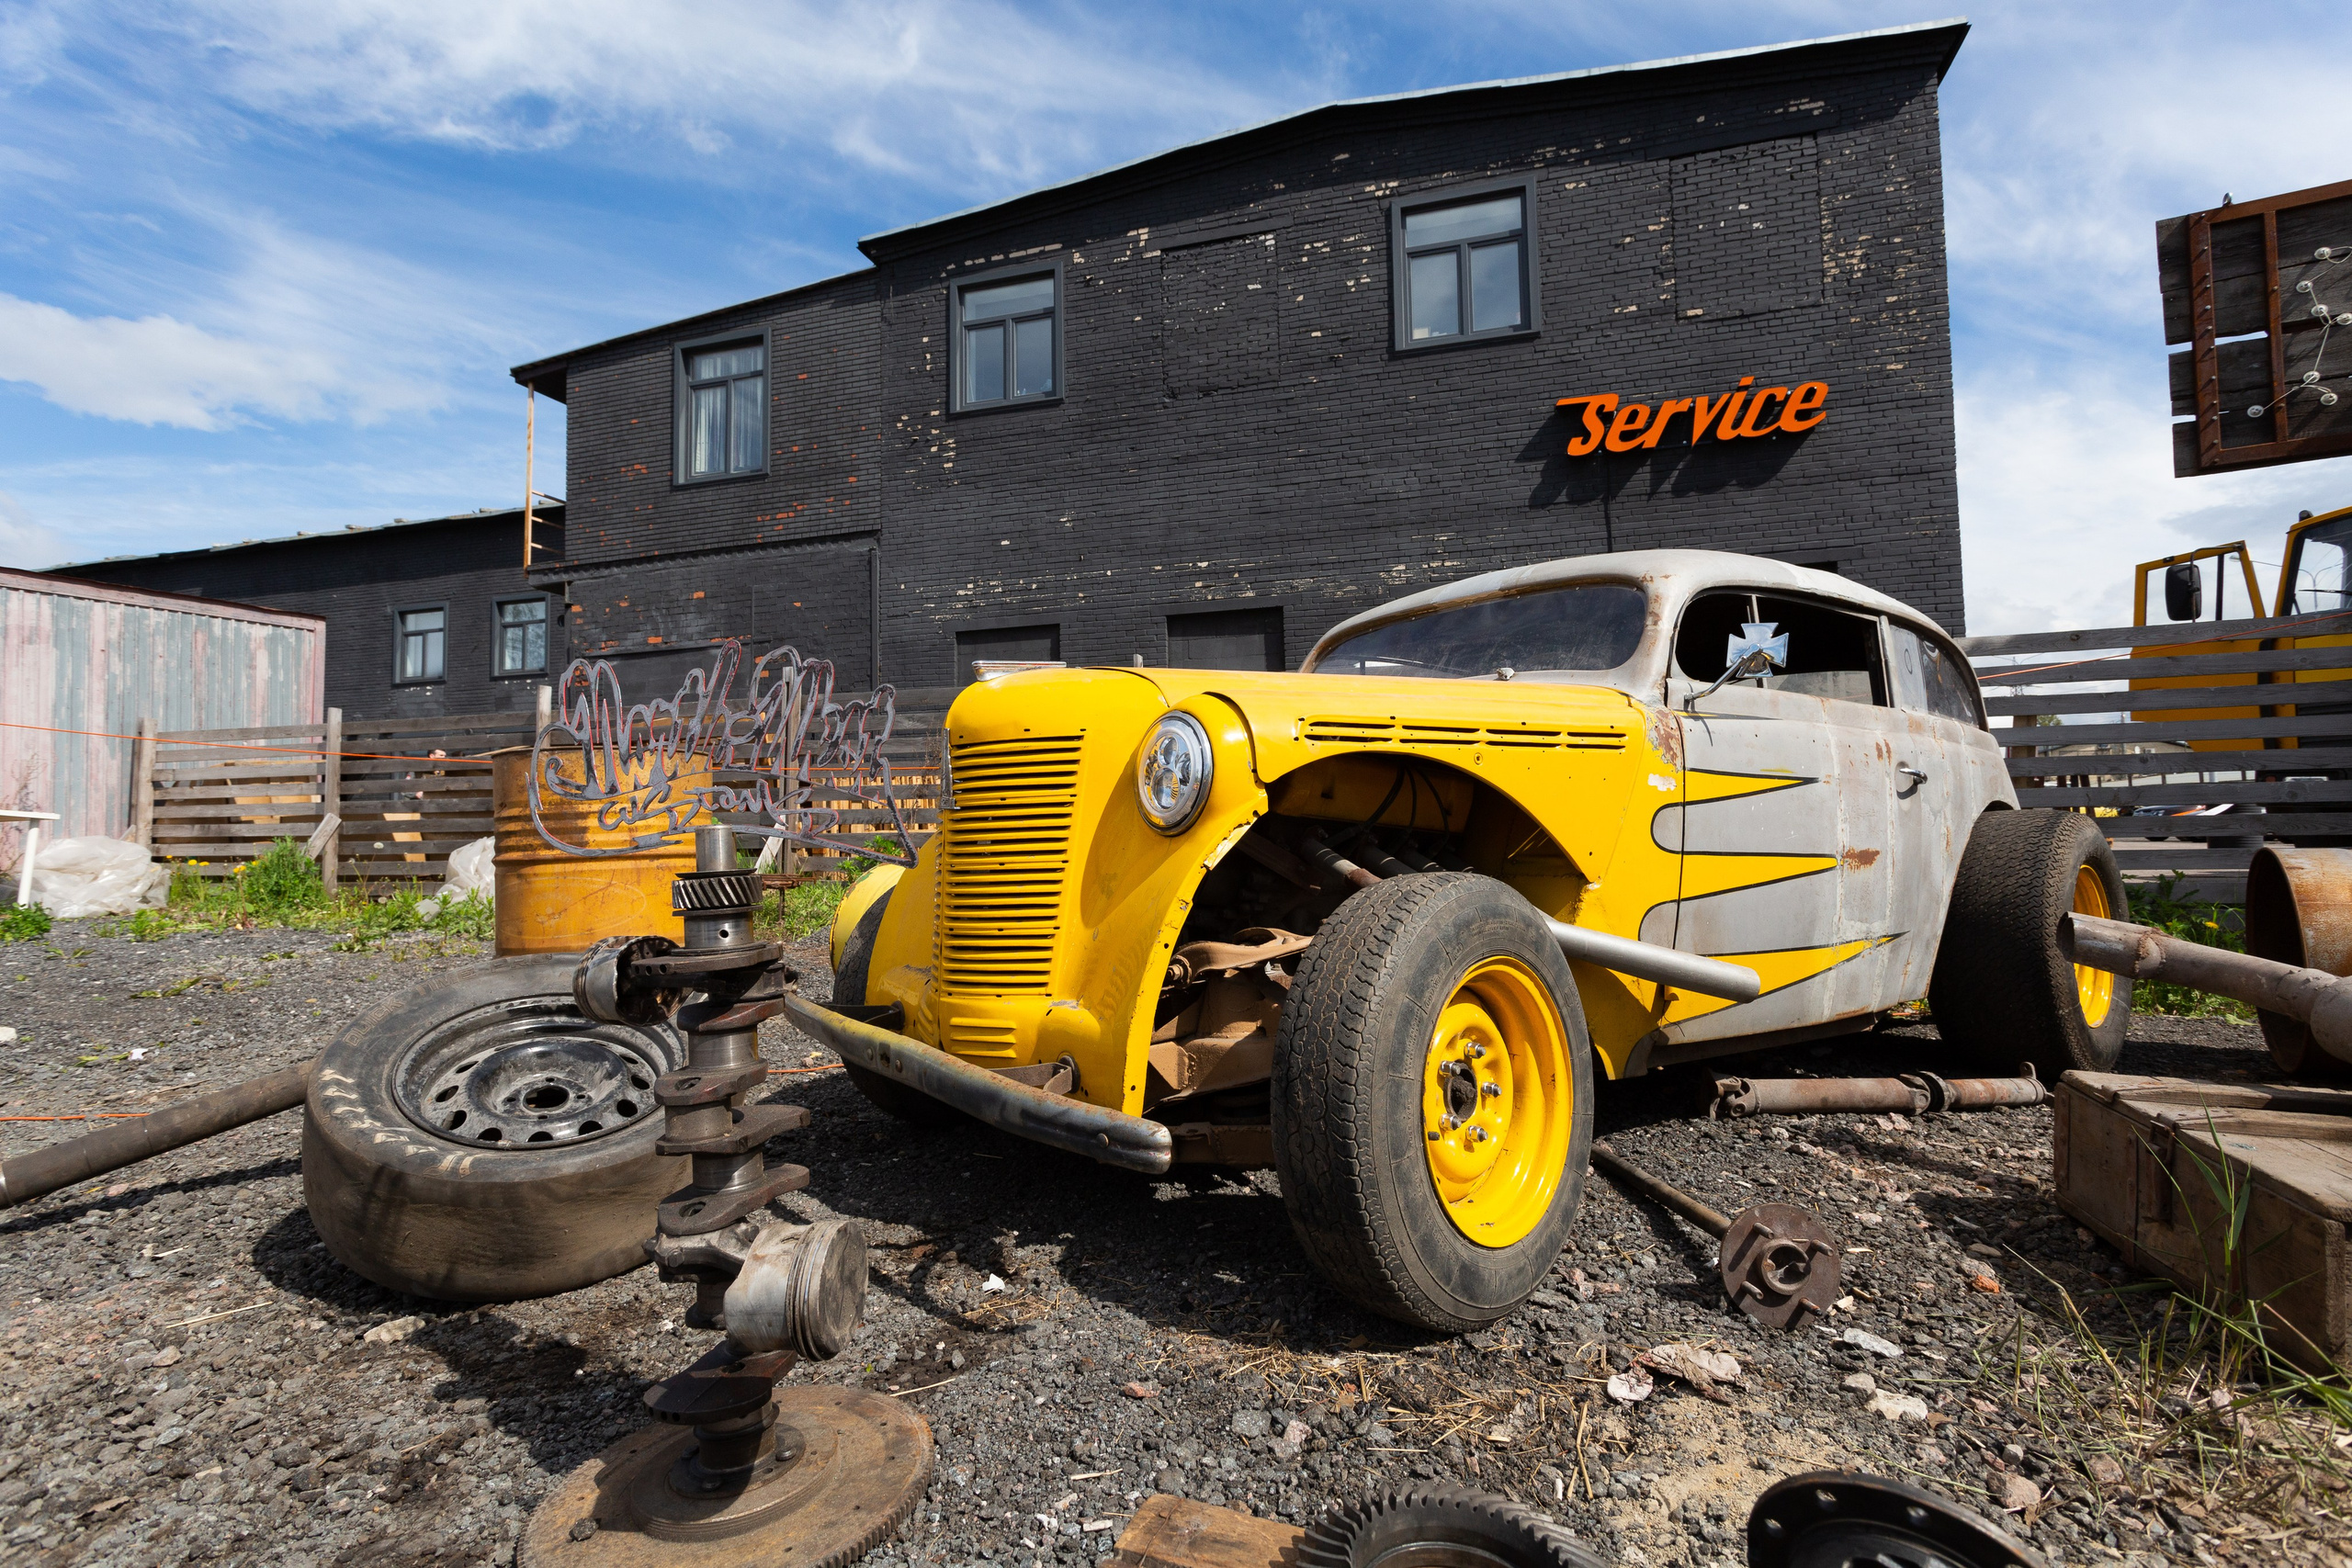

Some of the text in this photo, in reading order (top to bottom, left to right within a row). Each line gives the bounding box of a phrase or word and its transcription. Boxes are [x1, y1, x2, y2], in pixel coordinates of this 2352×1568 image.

[1555, 376, 1829, 457] Service
[341, 998, 405, 1047] QUICK
[411, 966, 477, 996] TIME
